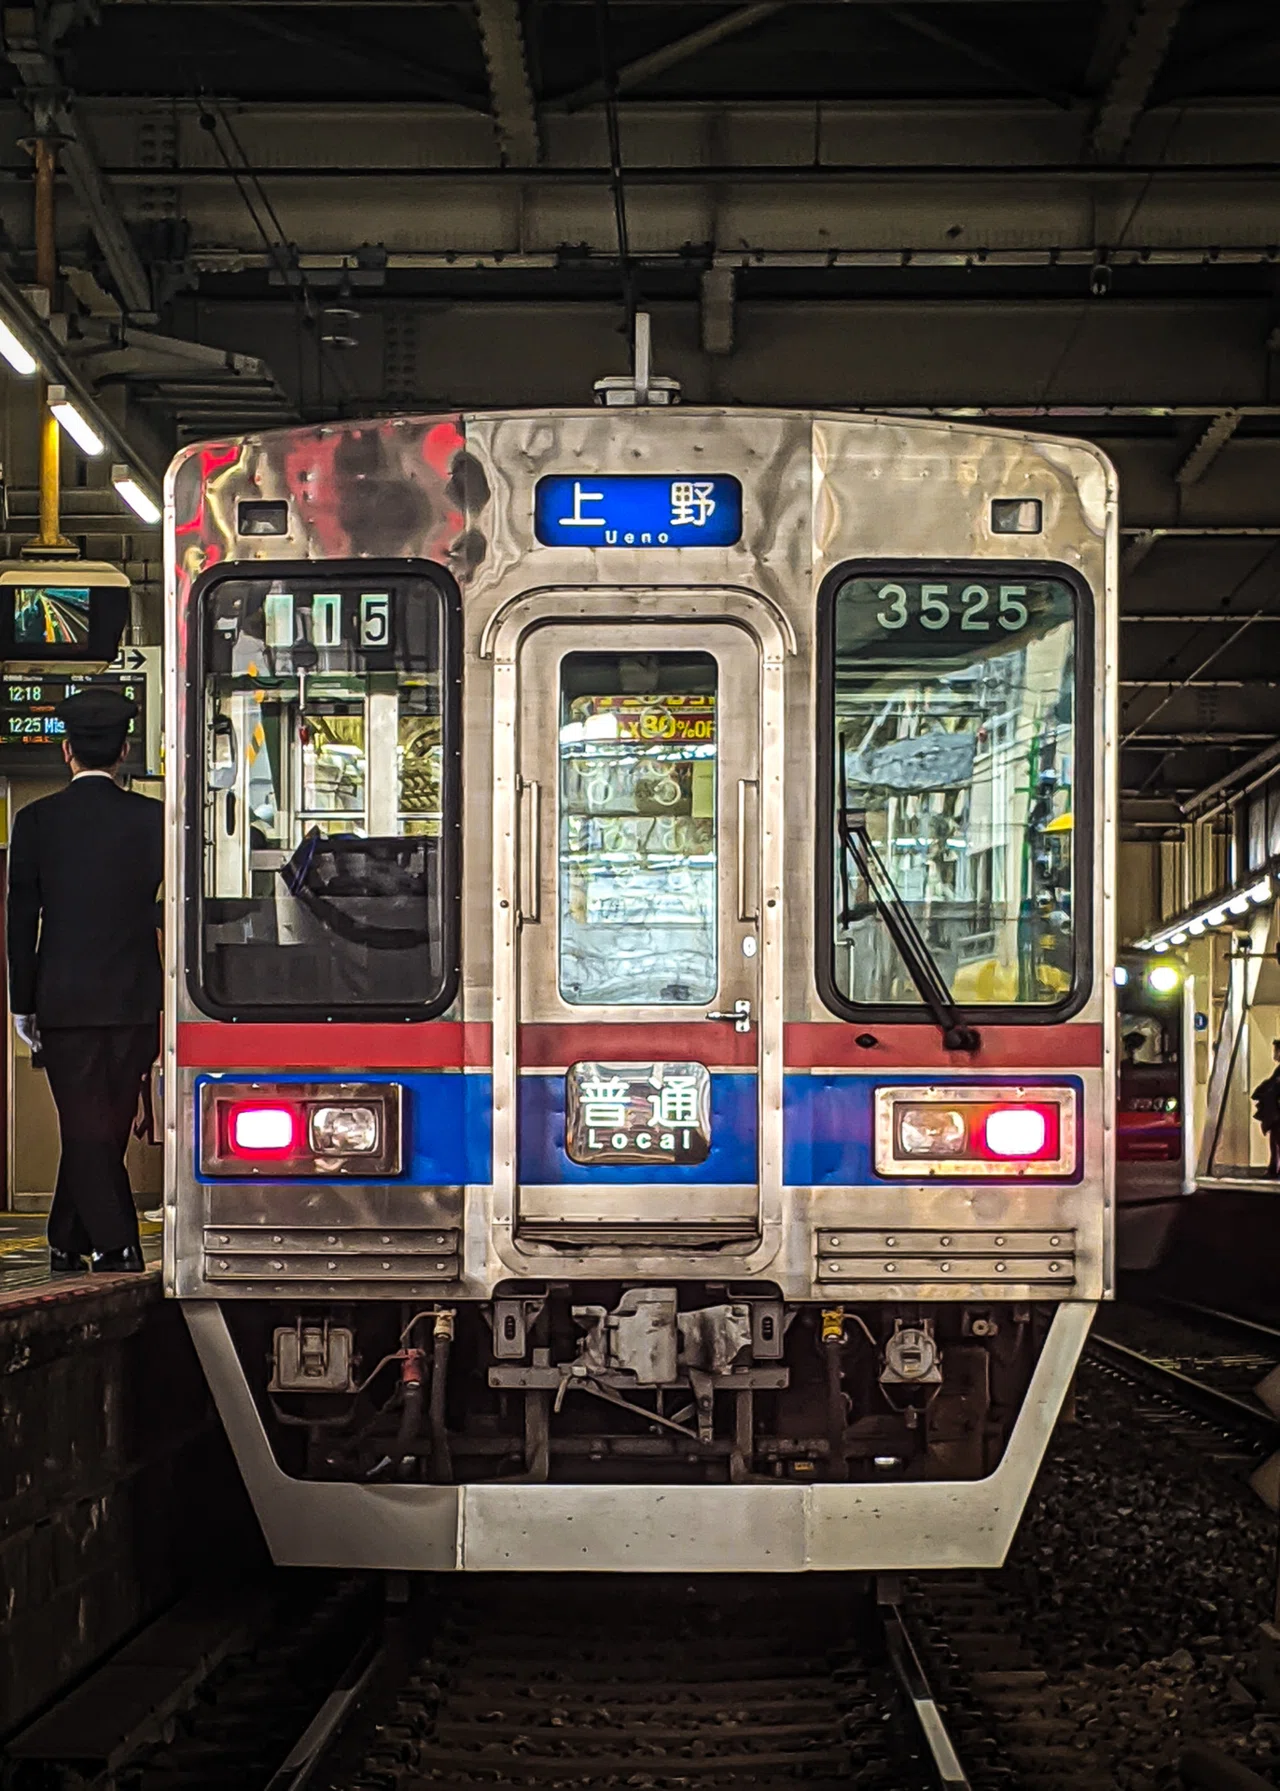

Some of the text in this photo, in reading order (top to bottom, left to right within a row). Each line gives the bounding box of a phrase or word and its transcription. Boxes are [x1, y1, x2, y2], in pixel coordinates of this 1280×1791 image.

[559, 482, 715, 526] 上野
[605, 530, 669, 544] Ueno
[876, 584, 1029, 632] 3525
[579, 1076, 700, 1127] 普通
[588, 1128, 690, 1150] Local
